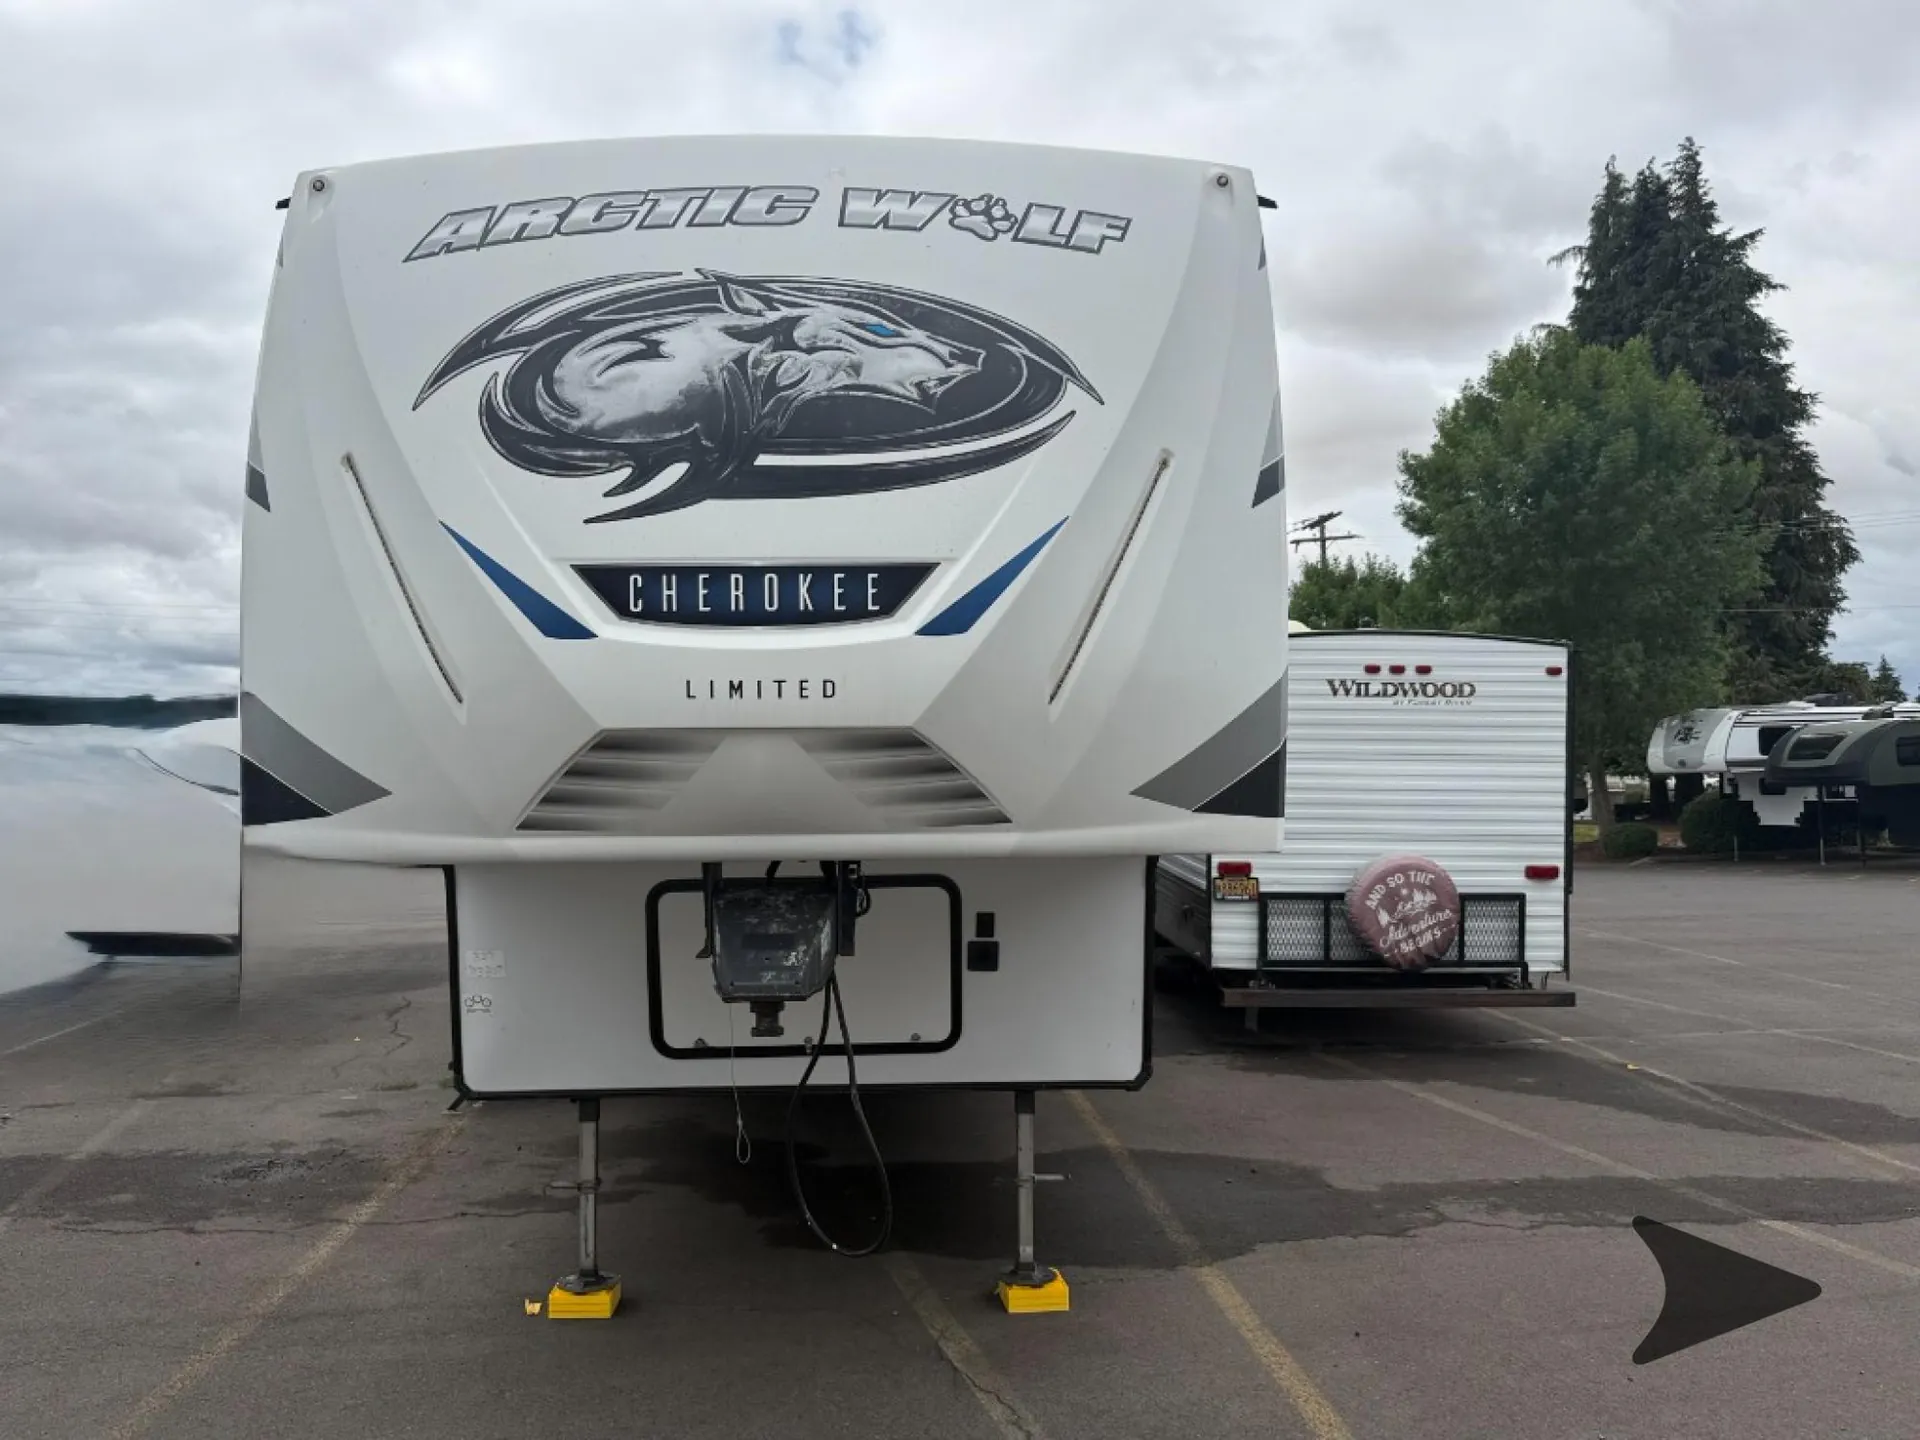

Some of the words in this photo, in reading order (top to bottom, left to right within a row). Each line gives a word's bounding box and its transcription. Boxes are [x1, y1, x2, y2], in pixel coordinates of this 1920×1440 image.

[404, 185, 819, 262] ARCTIC
[628, 572, 881, 613] CHEROKEE
[685, 679, 837, 699] LIMITED
[1365, 884, 1386, 910] AND
[1387, 873, 1405, 888] SO
